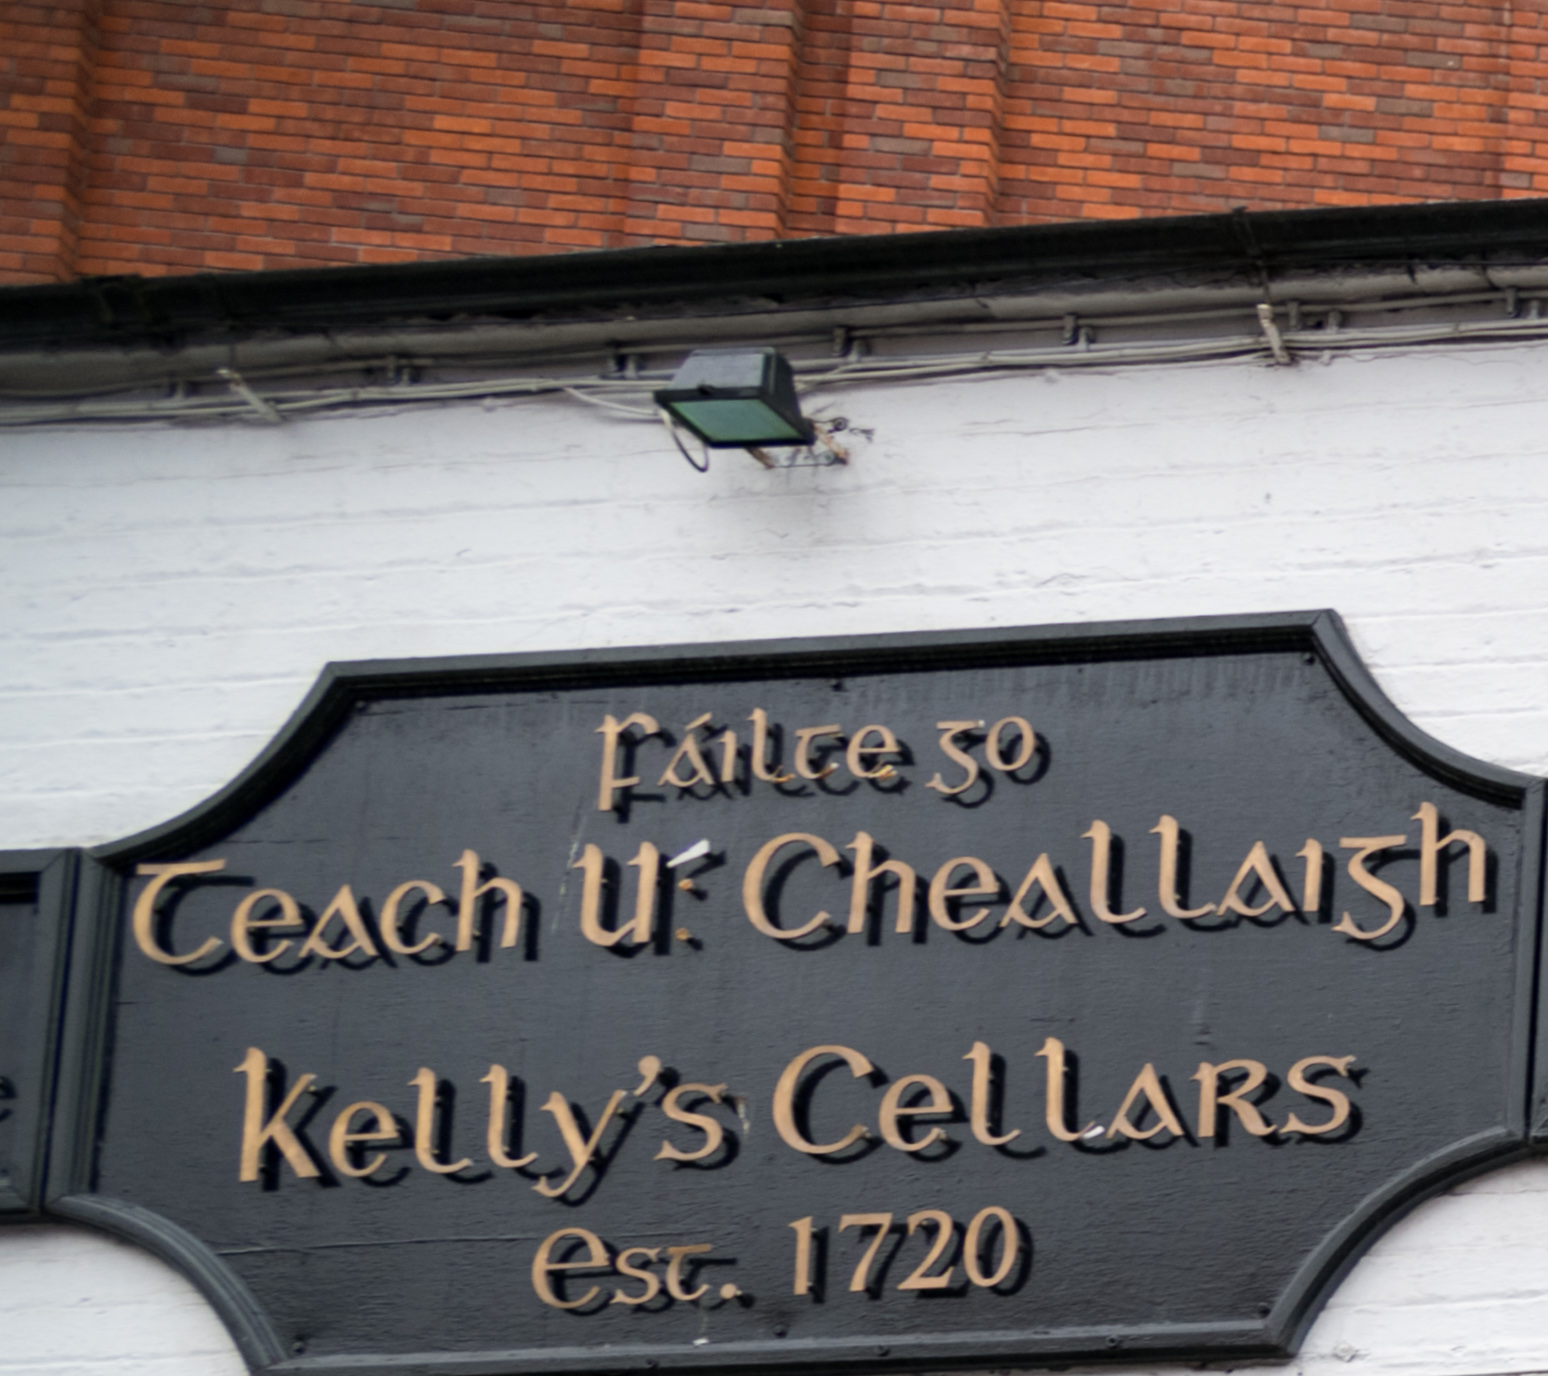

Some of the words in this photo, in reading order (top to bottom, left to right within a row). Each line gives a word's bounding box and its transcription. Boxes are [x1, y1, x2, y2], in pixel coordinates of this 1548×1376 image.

[925, 716, 1036, 795] go
[133, 849, 524, 966] Teach
[743, 802, 1487, 941] Cheallaigh
[233, 1047, 730, 1198] Kelly's
[772, 1037, 1357, 1154] Cellars
[789, 1206, 1020, 1296] 1720
